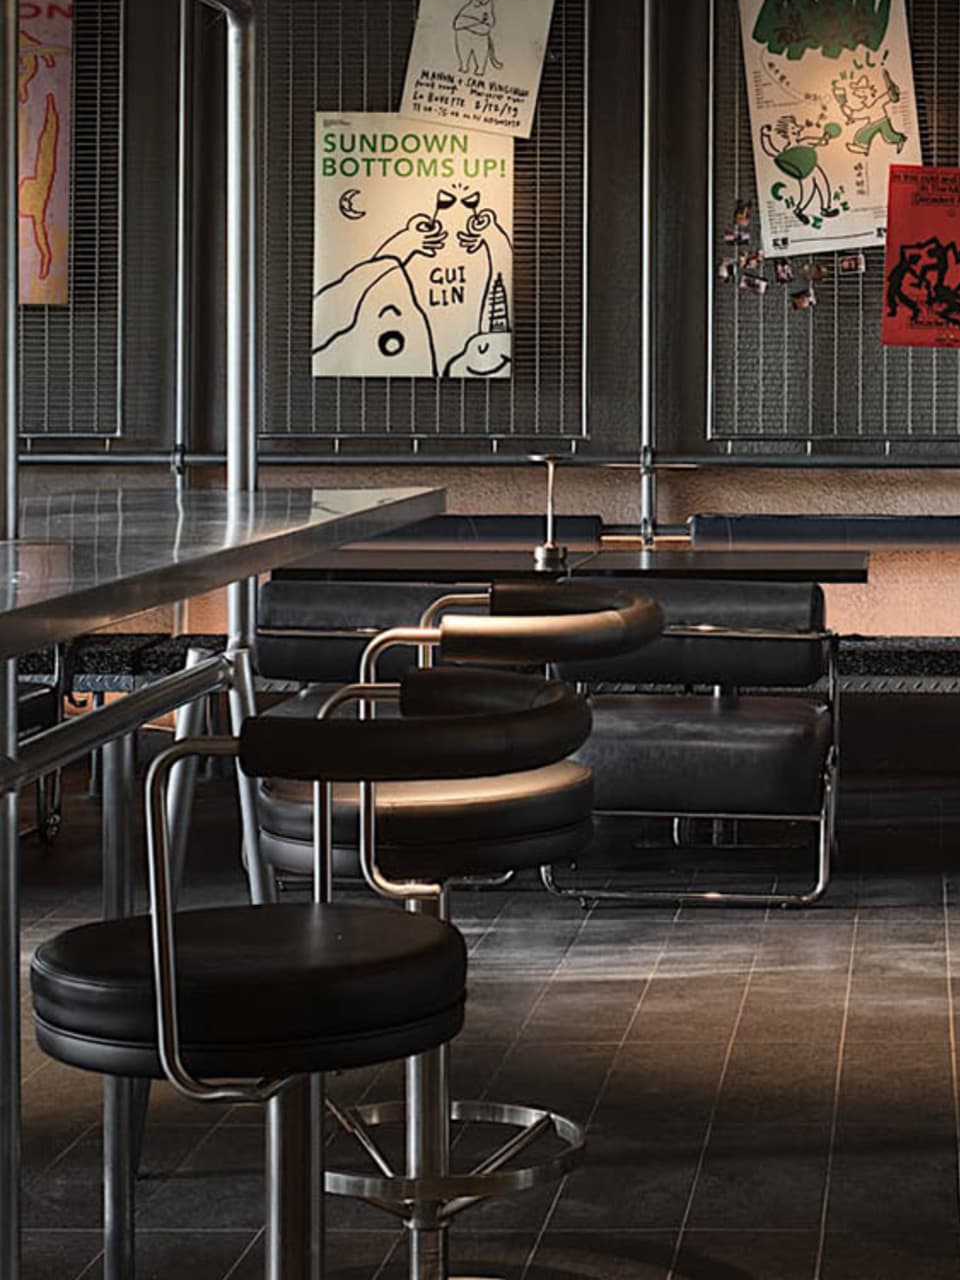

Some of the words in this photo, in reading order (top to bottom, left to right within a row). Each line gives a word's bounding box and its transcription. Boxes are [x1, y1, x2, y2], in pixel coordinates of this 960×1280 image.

[323, 133, 468, 153] SUNDOWN
[322, 158, 454, 177] BOTTOMS
[463, 159, 507, 178] UP!
[430, 266, 466, 284] GUI
[429, 286, 464, 306] LIN
